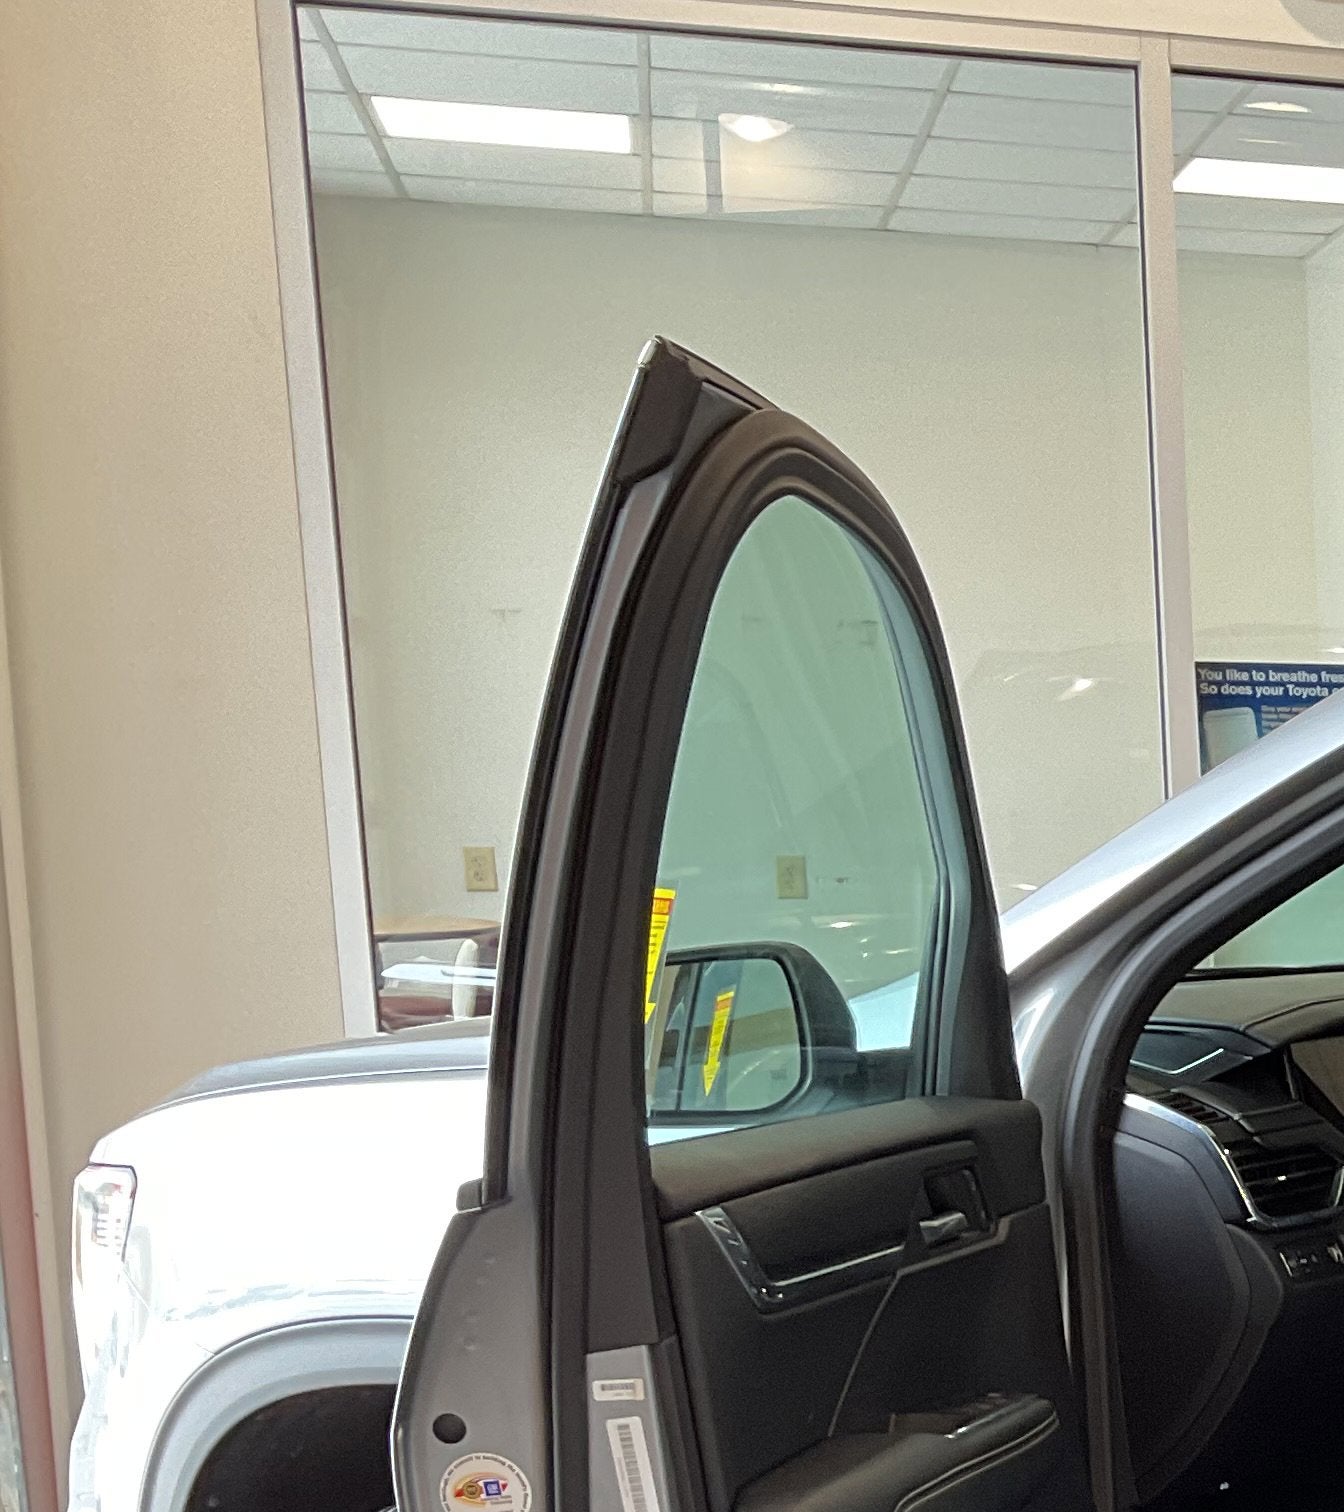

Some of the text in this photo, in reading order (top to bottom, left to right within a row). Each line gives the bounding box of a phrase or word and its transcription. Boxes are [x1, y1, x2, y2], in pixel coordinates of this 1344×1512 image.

[1198, 669, 1223, 682] You
[1225, 669, 1250, 682] like
[1252, 670, 1266, 682] to
[1268, 670, 1319, 683] breathe
[1199, 683, 1219, 695] So
[1220, 683, 1253, 695] does
[1255, 685, 1285, 698] your
[1287, 684, 1330, 699] Toyota
